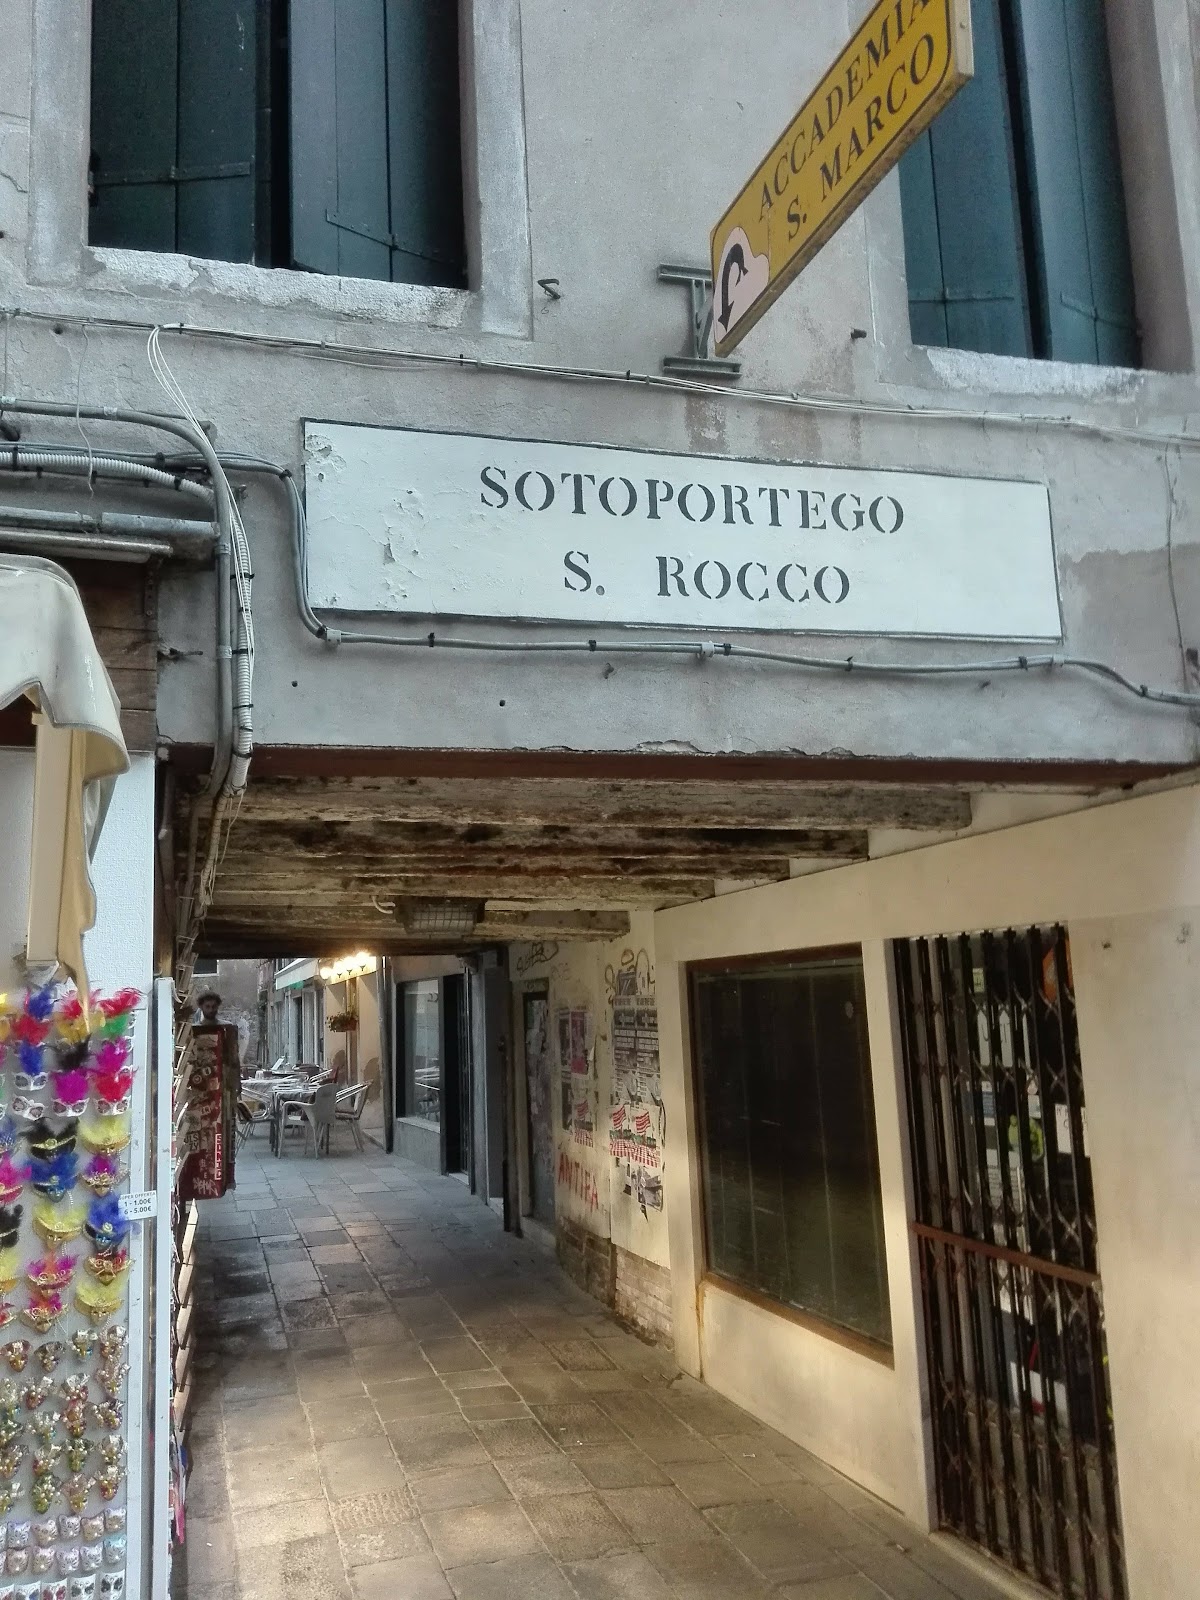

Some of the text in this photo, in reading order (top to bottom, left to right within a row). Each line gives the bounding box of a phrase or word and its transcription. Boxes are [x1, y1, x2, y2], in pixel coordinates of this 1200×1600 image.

[786, 33, 934, 242] S. MARCO
[480, 466, 904, 534] SOTOPORTEGO
[563, 550, 850, 604] S. ROCCO
[558, 1152, 598, 1213] ANTIFA
